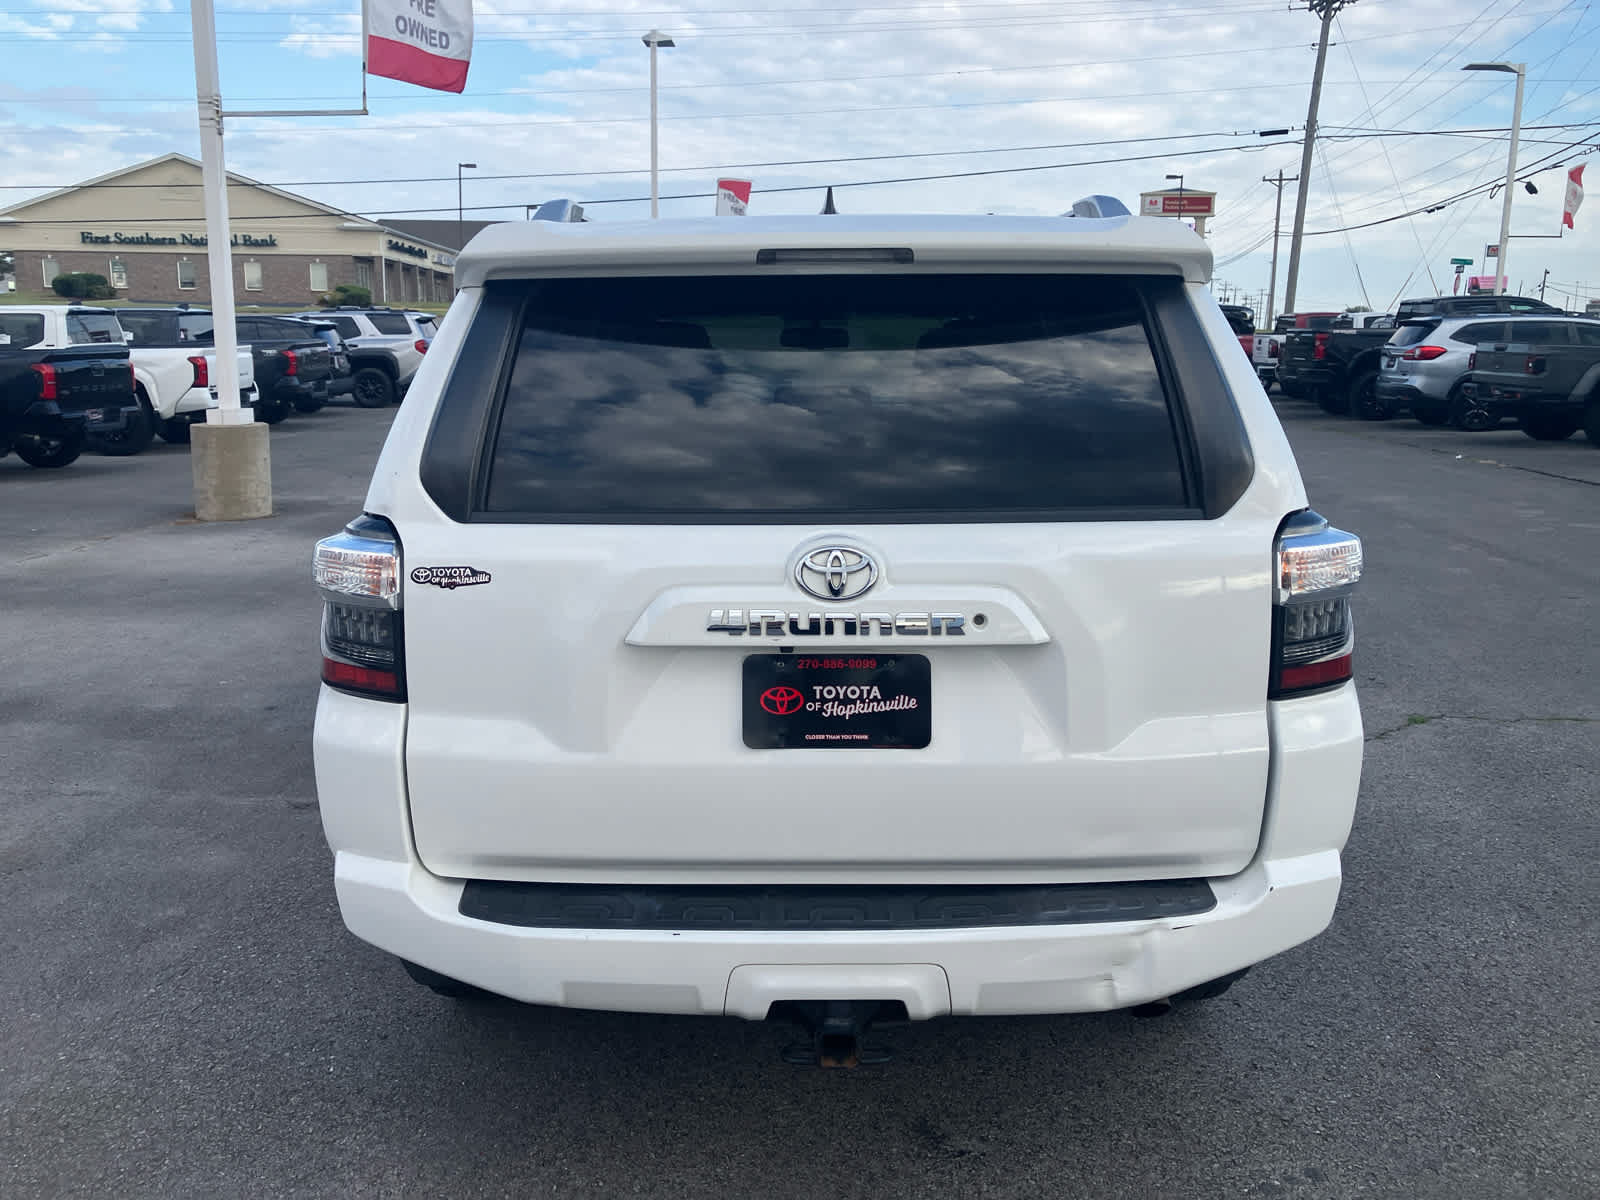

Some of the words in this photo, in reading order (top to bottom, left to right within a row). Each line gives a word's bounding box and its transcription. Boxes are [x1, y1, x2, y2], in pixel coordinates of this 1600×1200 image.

[395, 15, 450, 50] OWNED
[80, 231, 111, 245] First
[114, 231, 177, 246] Southern
[181, 233, 238, 248] Natil
[242, 234, 278, 248] Bank
[432, 568, 472, 577] TOYOTA
[813, 685, 882, 700] TOYOTA
[806, 702, 822, 712] OF
[822, 694, 918, 720] Hopkinsville
